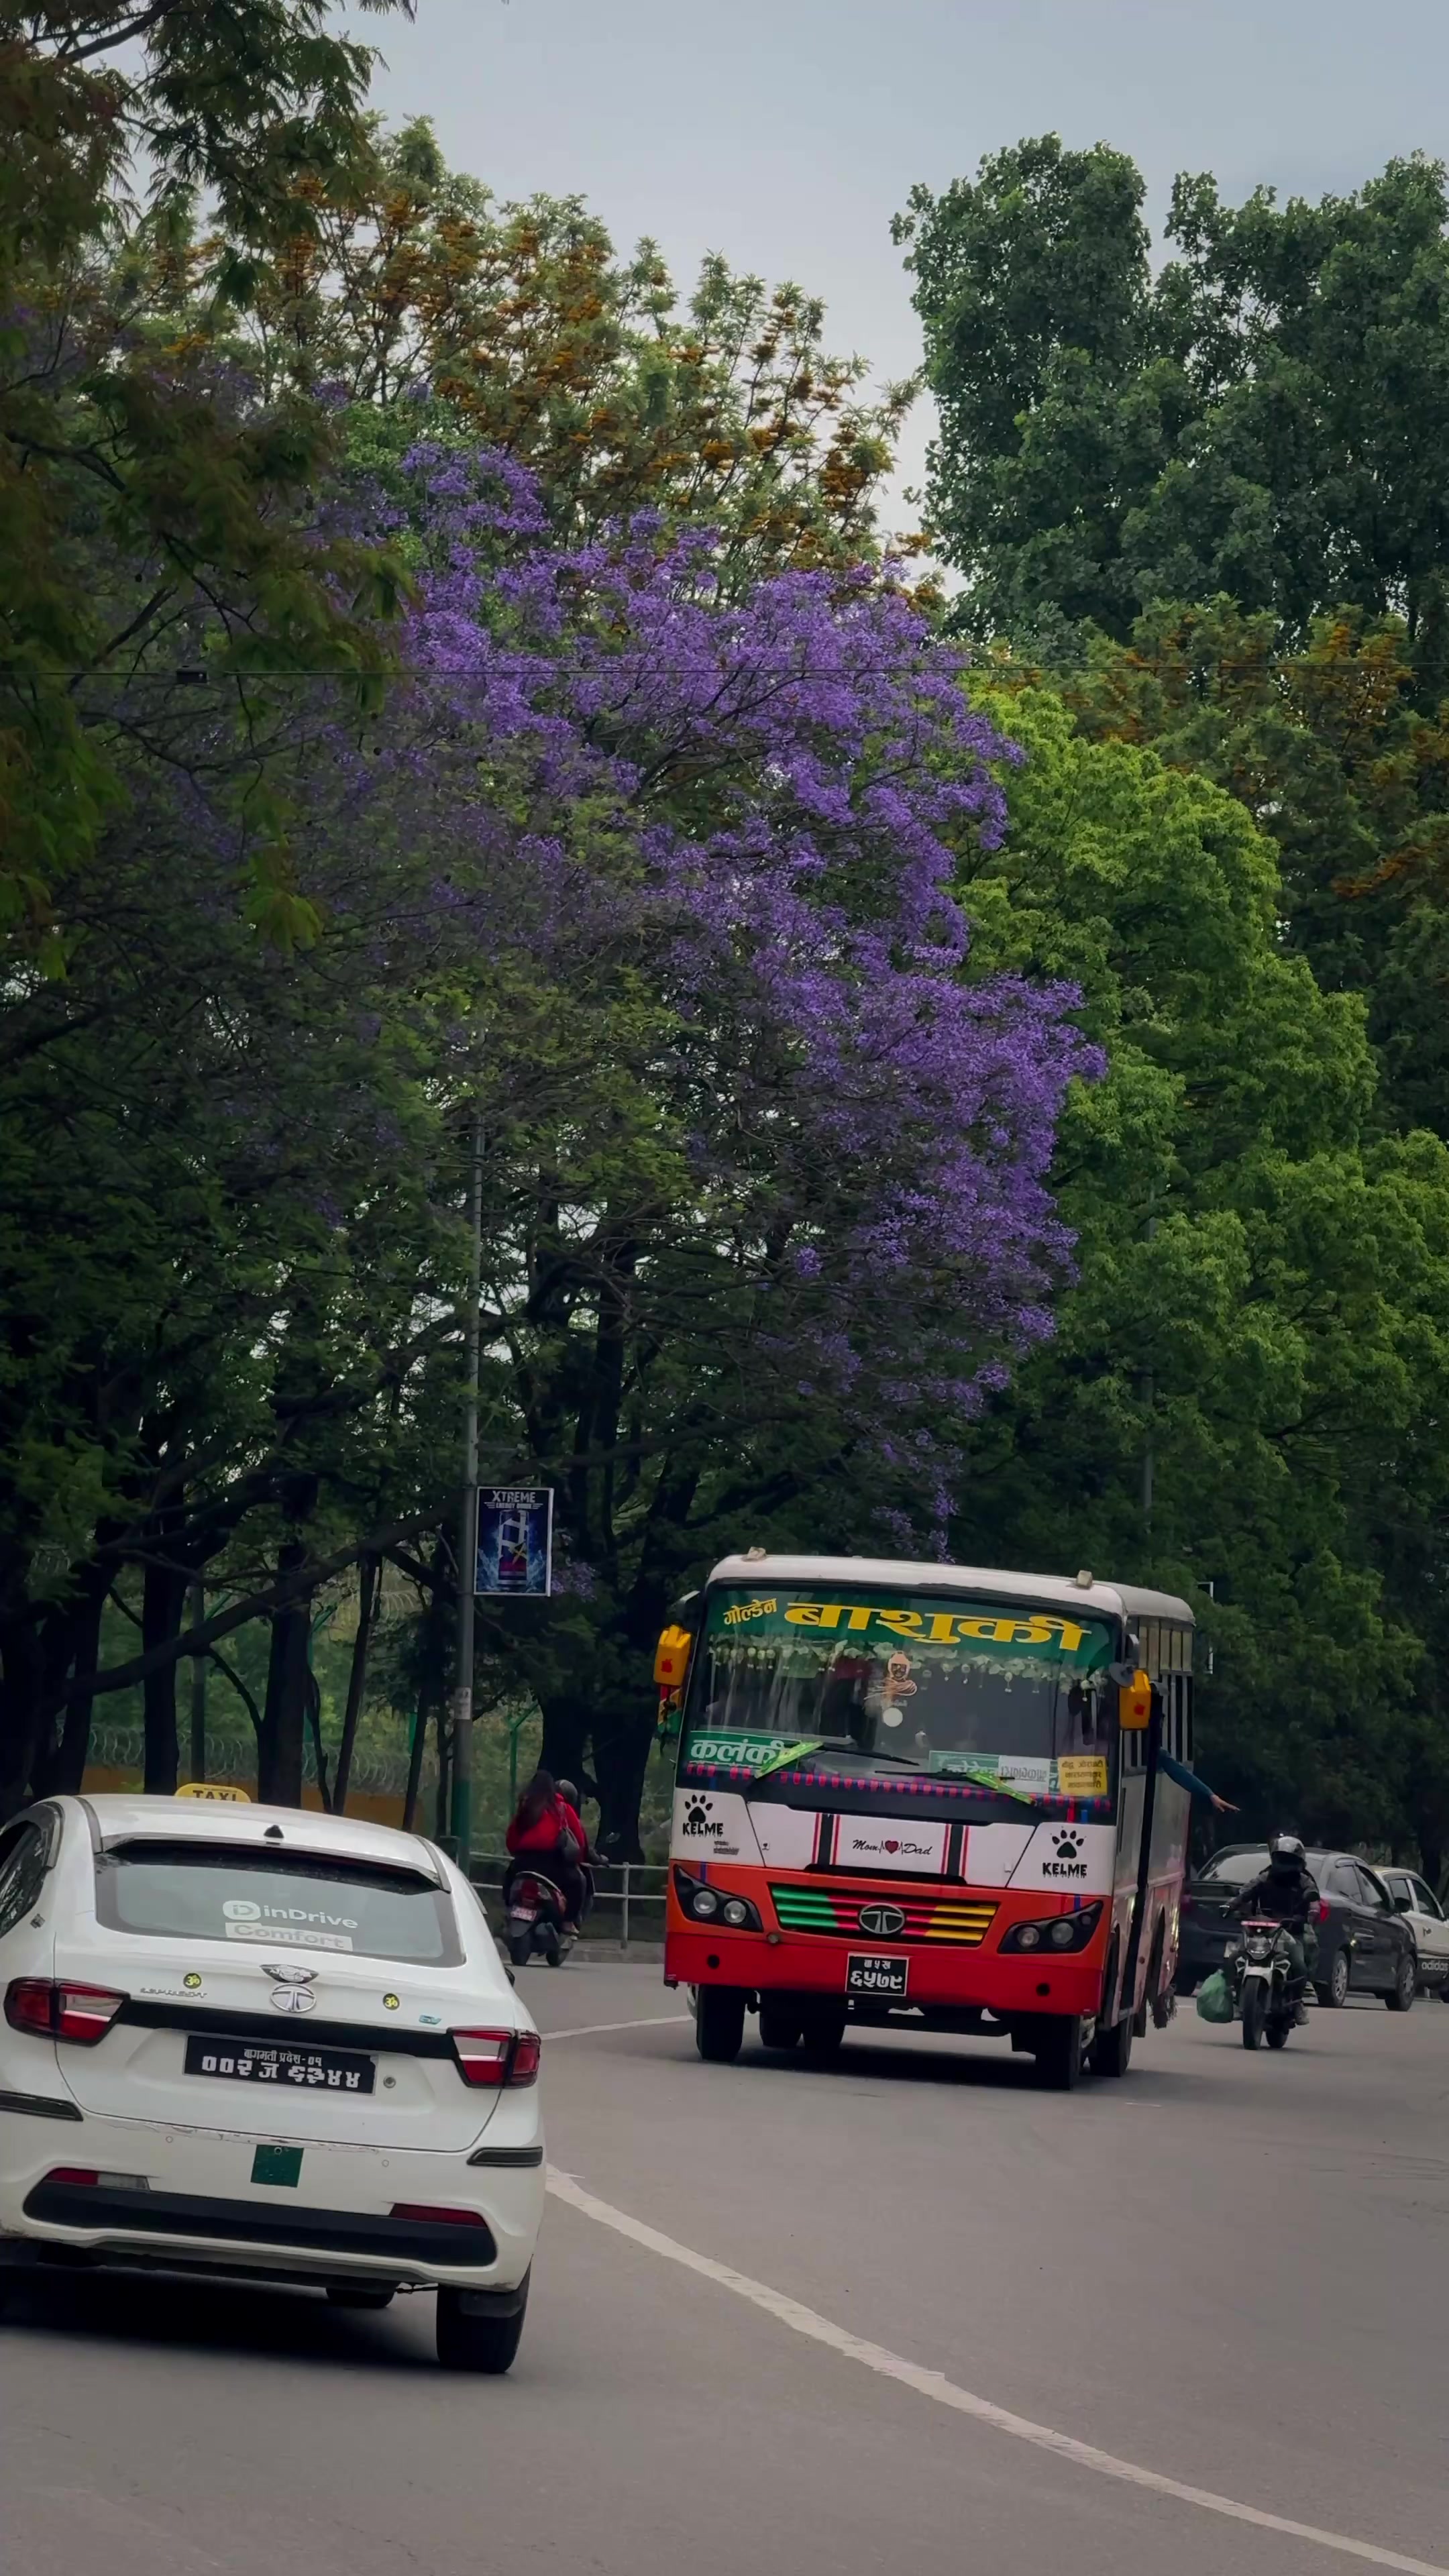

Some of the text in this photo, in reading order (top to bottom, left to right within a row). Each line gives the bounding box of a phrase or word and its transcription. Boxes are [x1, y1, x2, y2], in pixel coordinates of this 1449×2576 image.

[492, 1491, 536, 1503] XTREME
[193, 1790, 236, 1801] TAXI
[682, 1822, 724, 1837] KELME
[853, 1839, 933, 1855] Mom Dad
[1042, 1862, 1087, 1878] KELME
[264, 1905, 358, 1929] inDrive
[235, 1925, 344, 1948] Comfort
[244, 2048, 278, 2061] बागमती
[258, 2061, 280, 2078] ज
